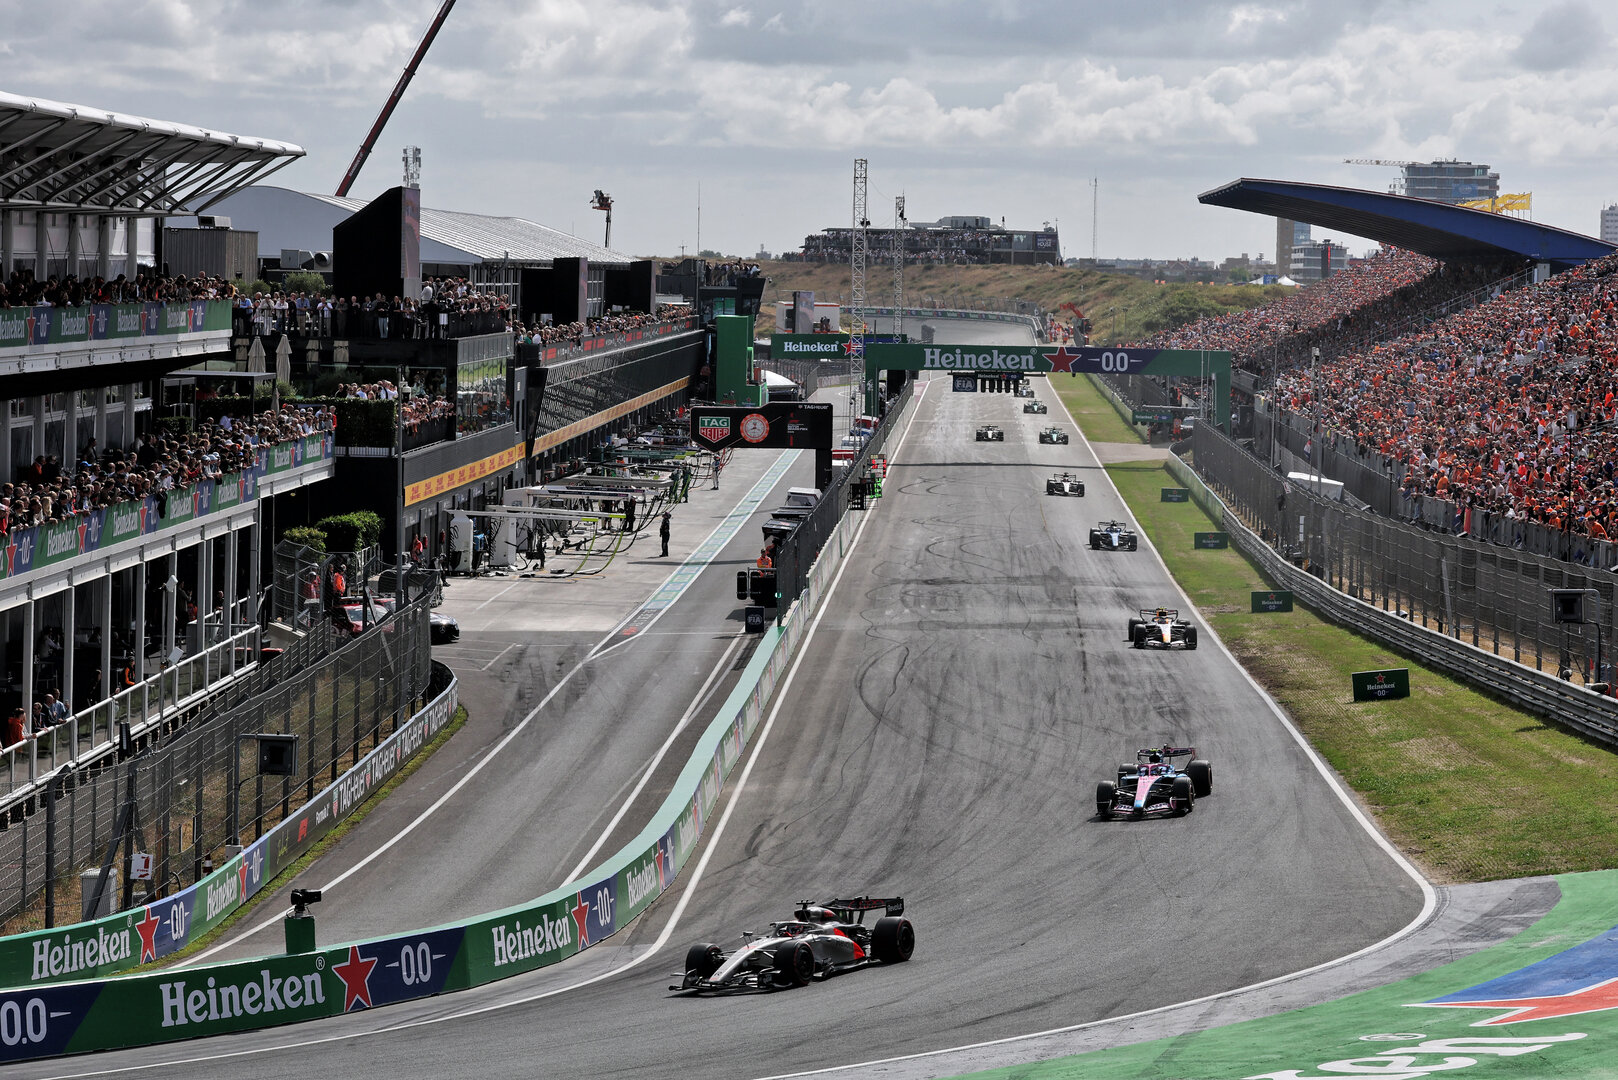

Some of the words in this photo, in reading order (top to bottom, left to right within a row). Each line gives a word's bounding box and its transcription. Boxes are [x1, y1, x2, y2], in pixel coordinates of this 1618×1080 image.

[783, 341, 839, 352] Heineken
[923, 348, 1035, 370] Heineken
[956, 379, 973, 388] FIA
[702, 418, 728, 427] TAG
[700, 428, 729, 441] HEUER
[1366, 682, 1396, 691] Heineken
[206, 871, 238, 922] Heineken
[492, 913, 572, 967] Heineken
[31, 927, 131, 981] Heineken
[159, 969, 326, 1028] Heineken
